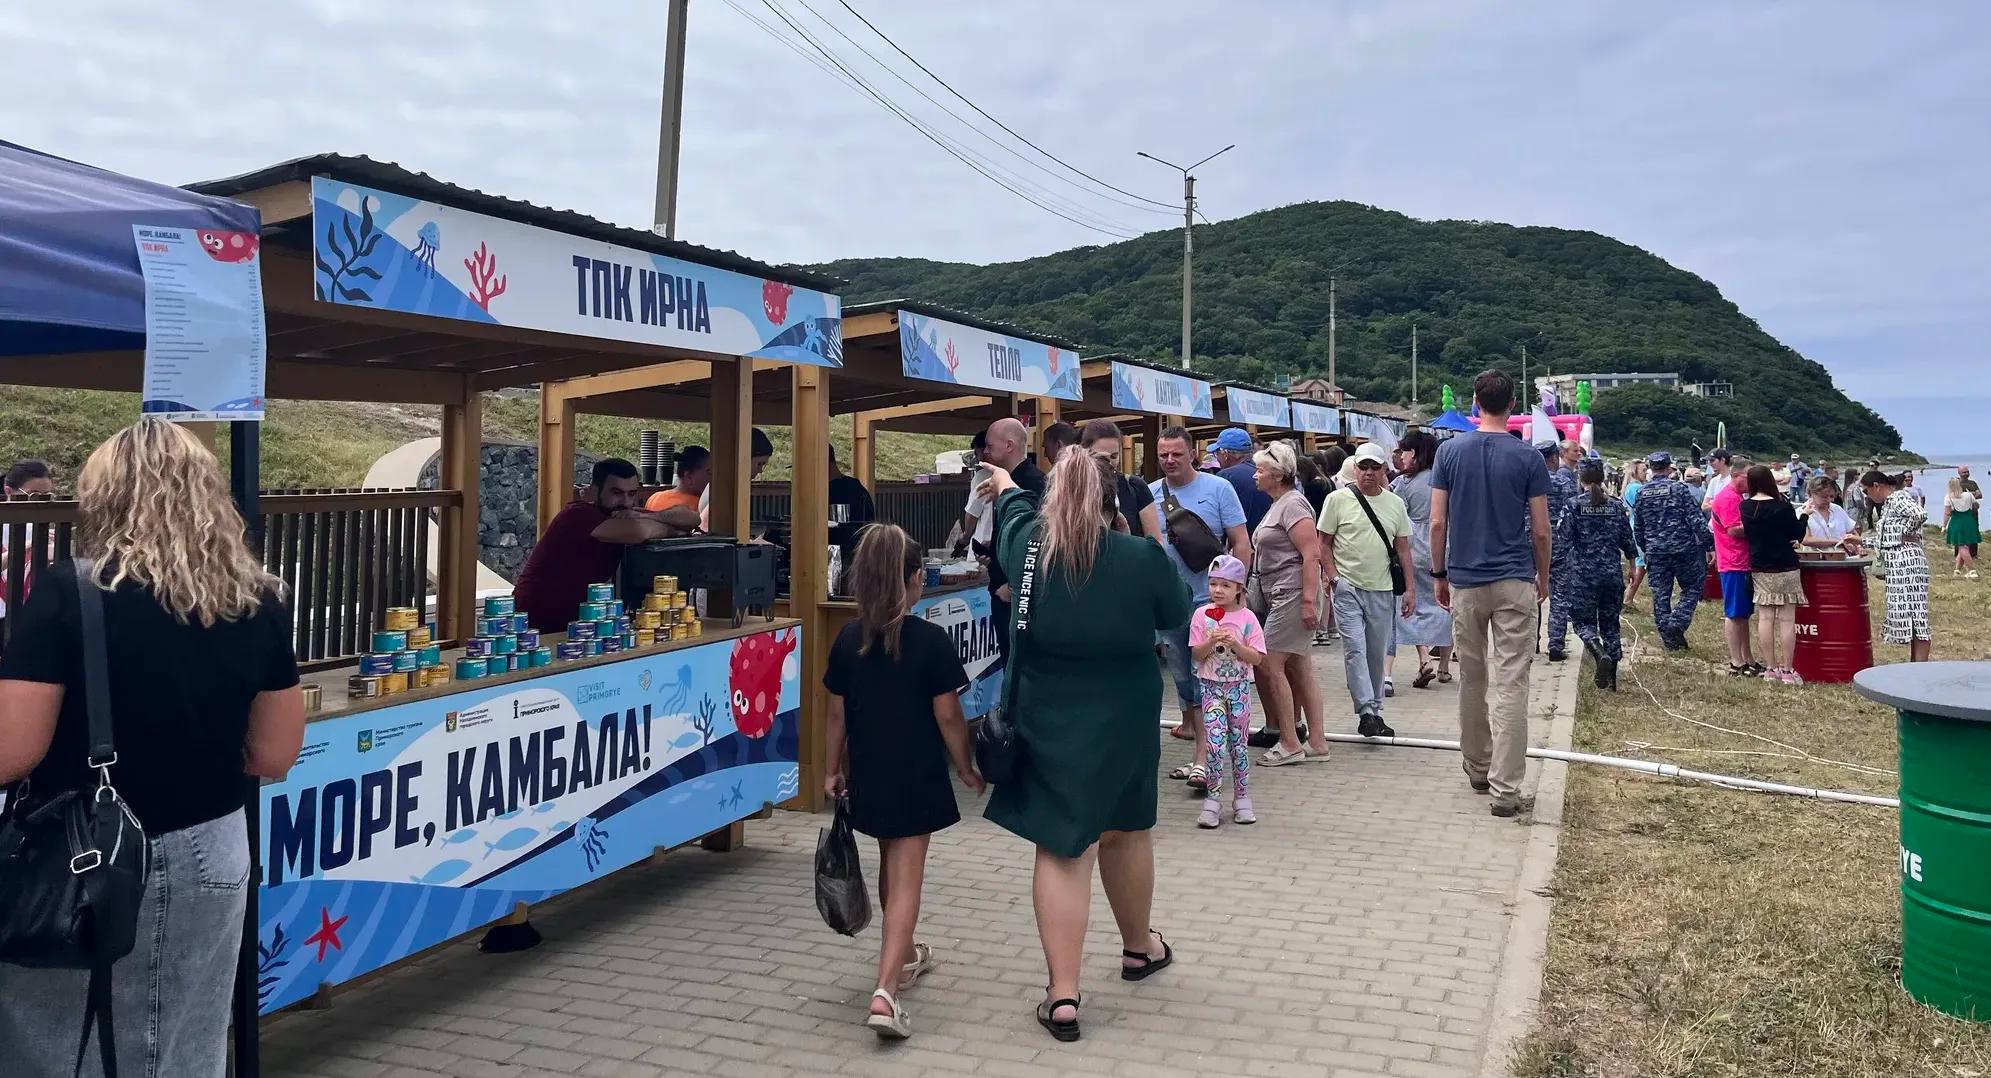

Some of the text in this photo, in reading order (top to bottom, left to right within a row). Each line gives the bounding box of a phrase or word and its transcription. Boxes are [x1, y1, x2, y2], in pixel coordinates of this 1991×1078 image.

[572, 255, 711, 334] ТПК ИРНА
[987, 343, 1022, 381] ТЕПЛО
[1020, 571, 1034, 596] NICE
[1018, 597, 1031, 615] NIC
[945, 615, 1000, 665] МБАЛА
[1794, 623, 1818, 636] RYE
[588, 687, 621, 701] PRIMORYE
[589, 681, 605, 692] VISIT
[268, 704, 651, 889] МОРЕ, КАМБАЛА!
[1900, 845, 1922, 882] YE
